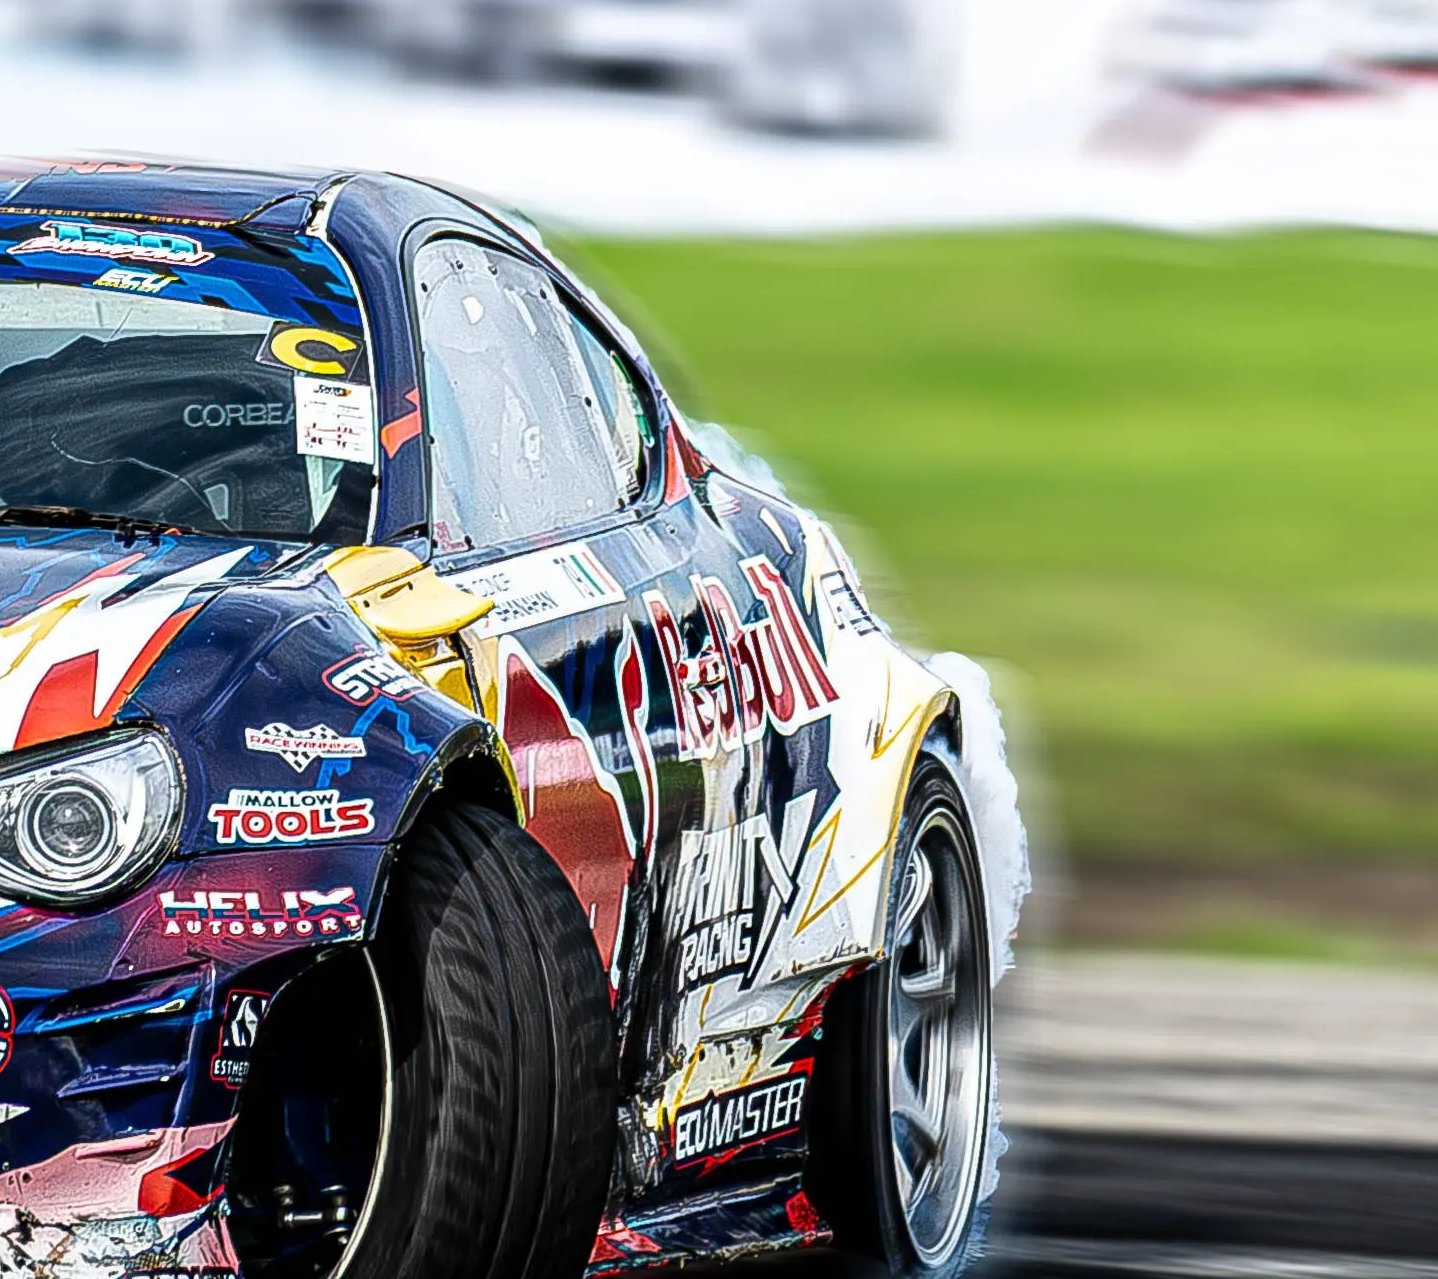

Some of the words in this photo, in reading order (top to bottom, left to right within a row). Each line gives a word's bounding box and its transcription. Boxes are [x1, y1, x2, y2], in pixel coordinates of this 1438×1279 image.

[271, 328, 356, 374] C
[184, 403, 295, 427] CORBEA
[706, 562, 840, 732] Bull
[250, 735, 290, 748] RACE
[245, 793, 334, 807] MALLOW
[214, 803, 370, 839] TOOLS
[159, 888, 359, 919] HELIX
[165, 915, 363, 936] AUTOSPORT
[675, 1077, 806, 1159] ECUMASTER
